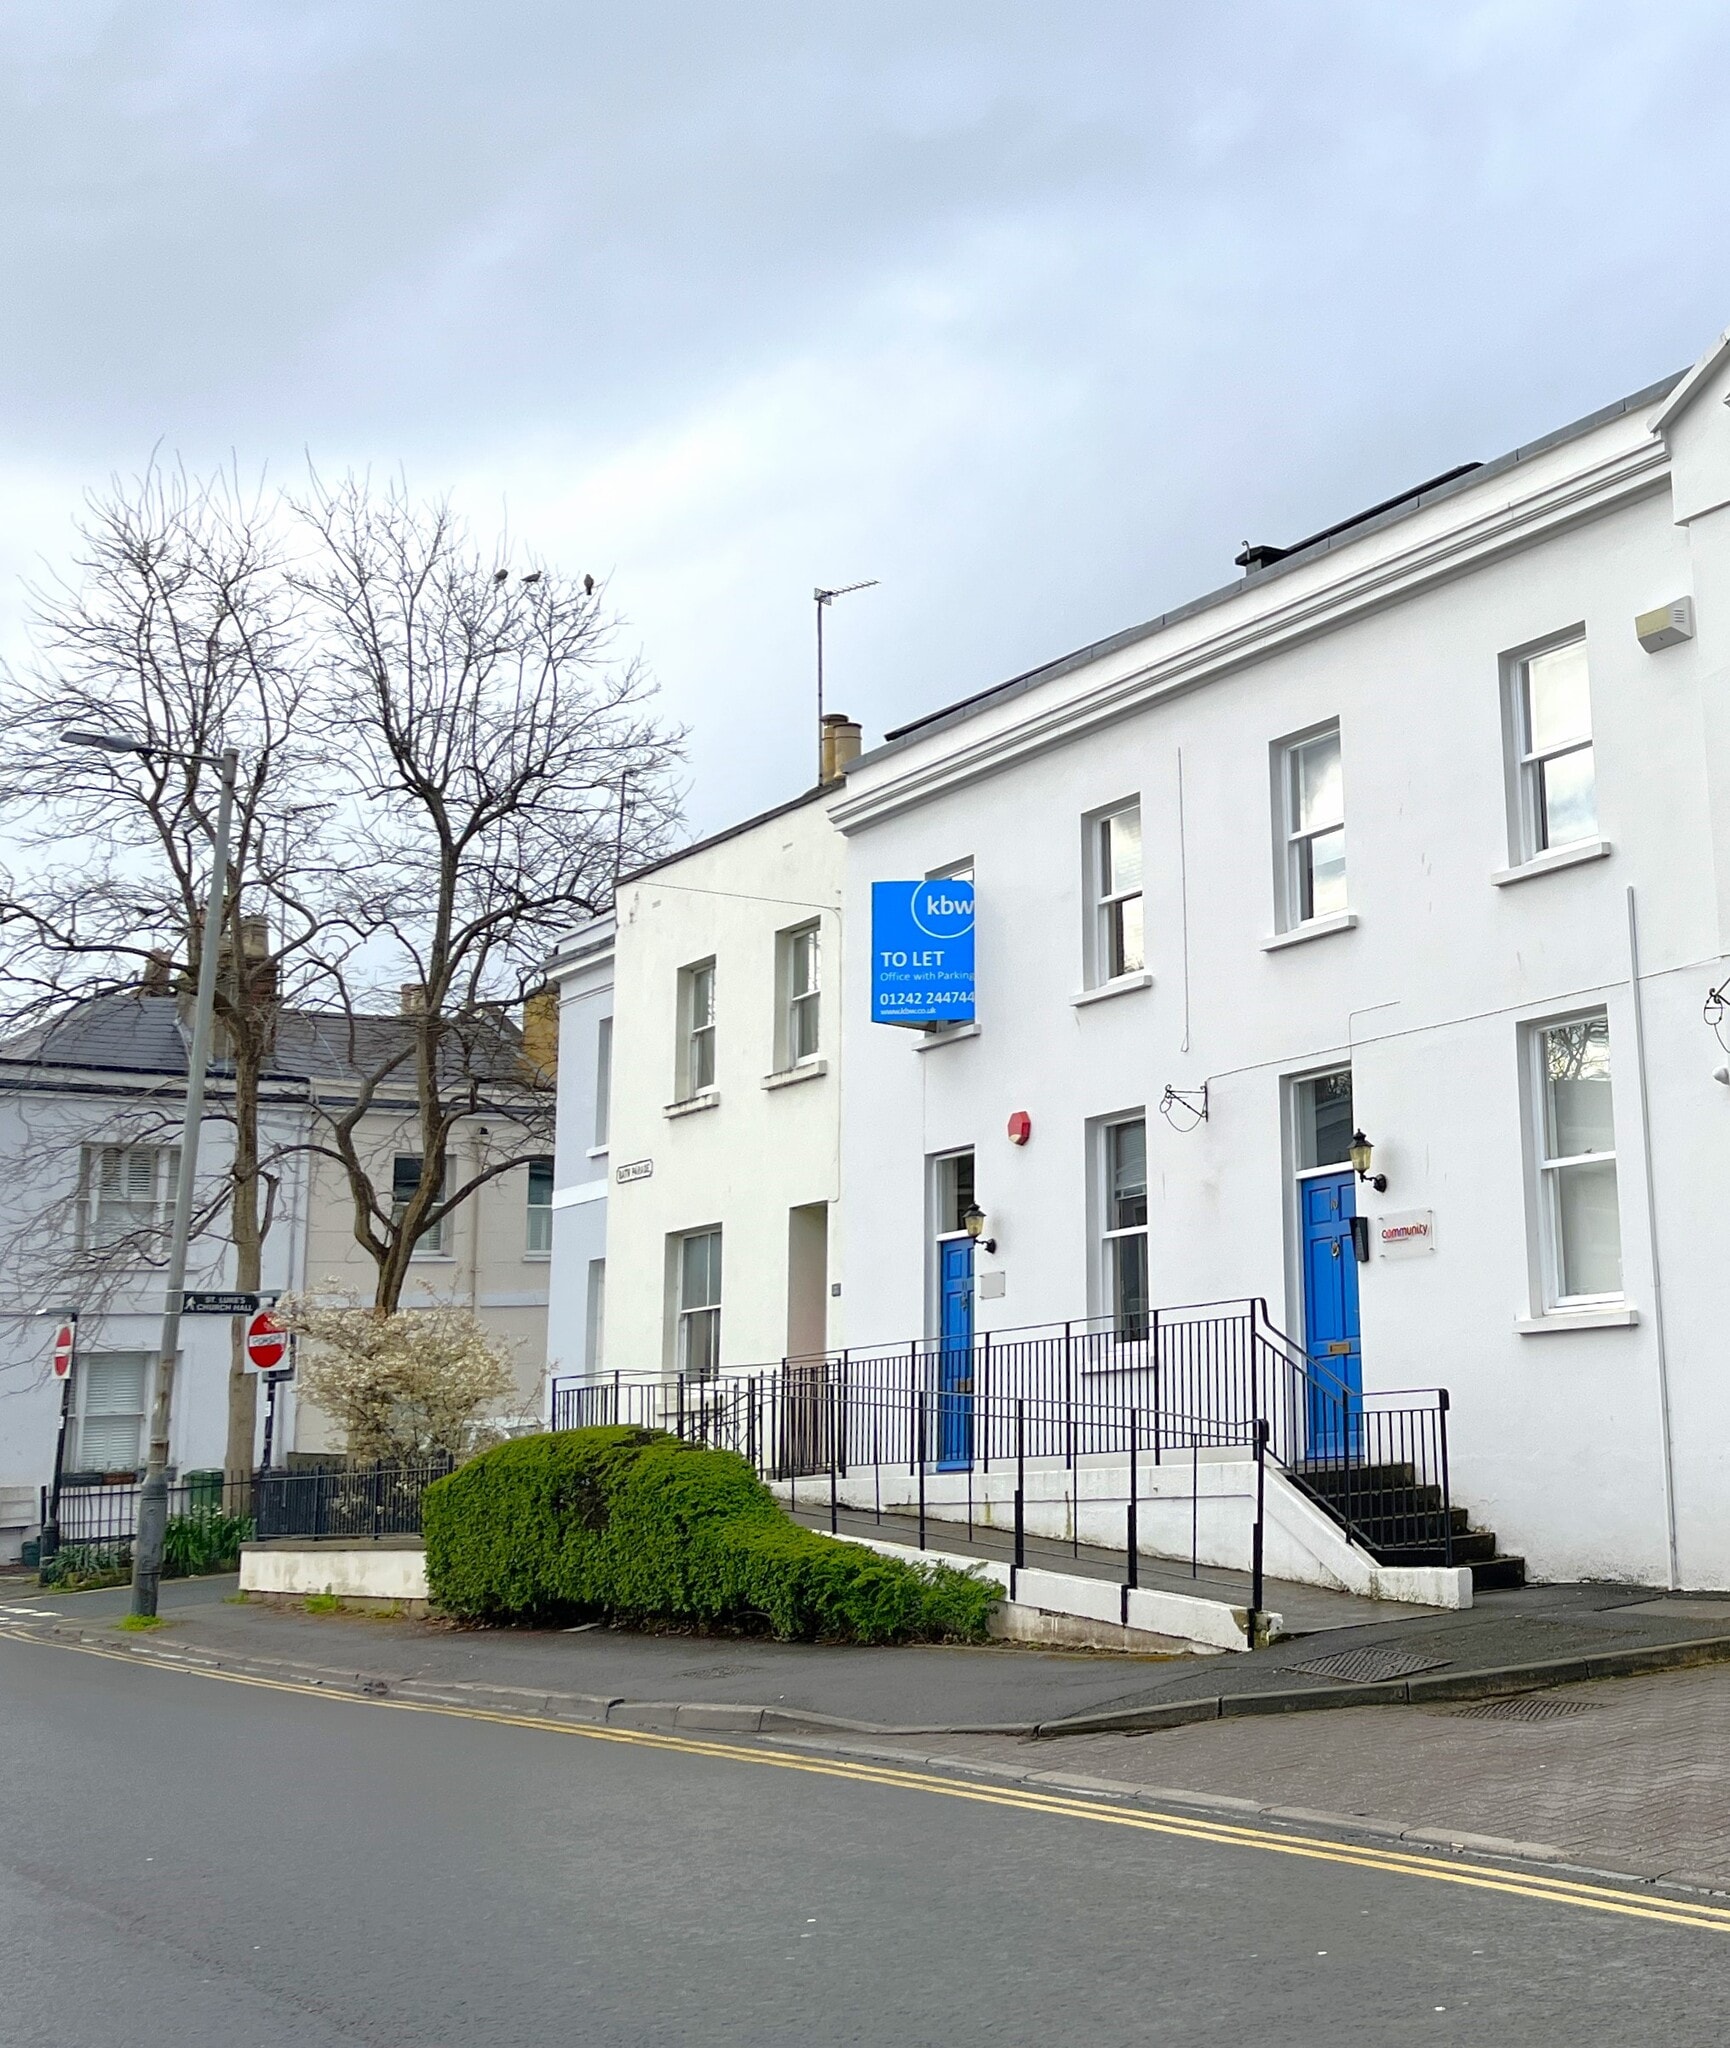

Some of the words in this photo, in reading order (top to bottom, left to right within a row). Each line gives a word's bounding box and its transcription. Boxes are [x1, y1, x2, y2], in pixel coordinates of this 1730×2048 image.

[927, 894, 975, 916] kbw
[880, 951, 908, 968] TO
[912, 950, 945, 967] LET
[880, 972, 911, 981] Office
[913, 971, 936, 981] with
[937, 970, 975, 982] Parking
[880, 992, 922, 1006] 01242
[926, 991, 975, 1004] 244744
[205, 1296, 217, 1304] ST.
[196, 1303, 232, 1311] CHURCH
[233, 1304, 253, 1312] HALL
